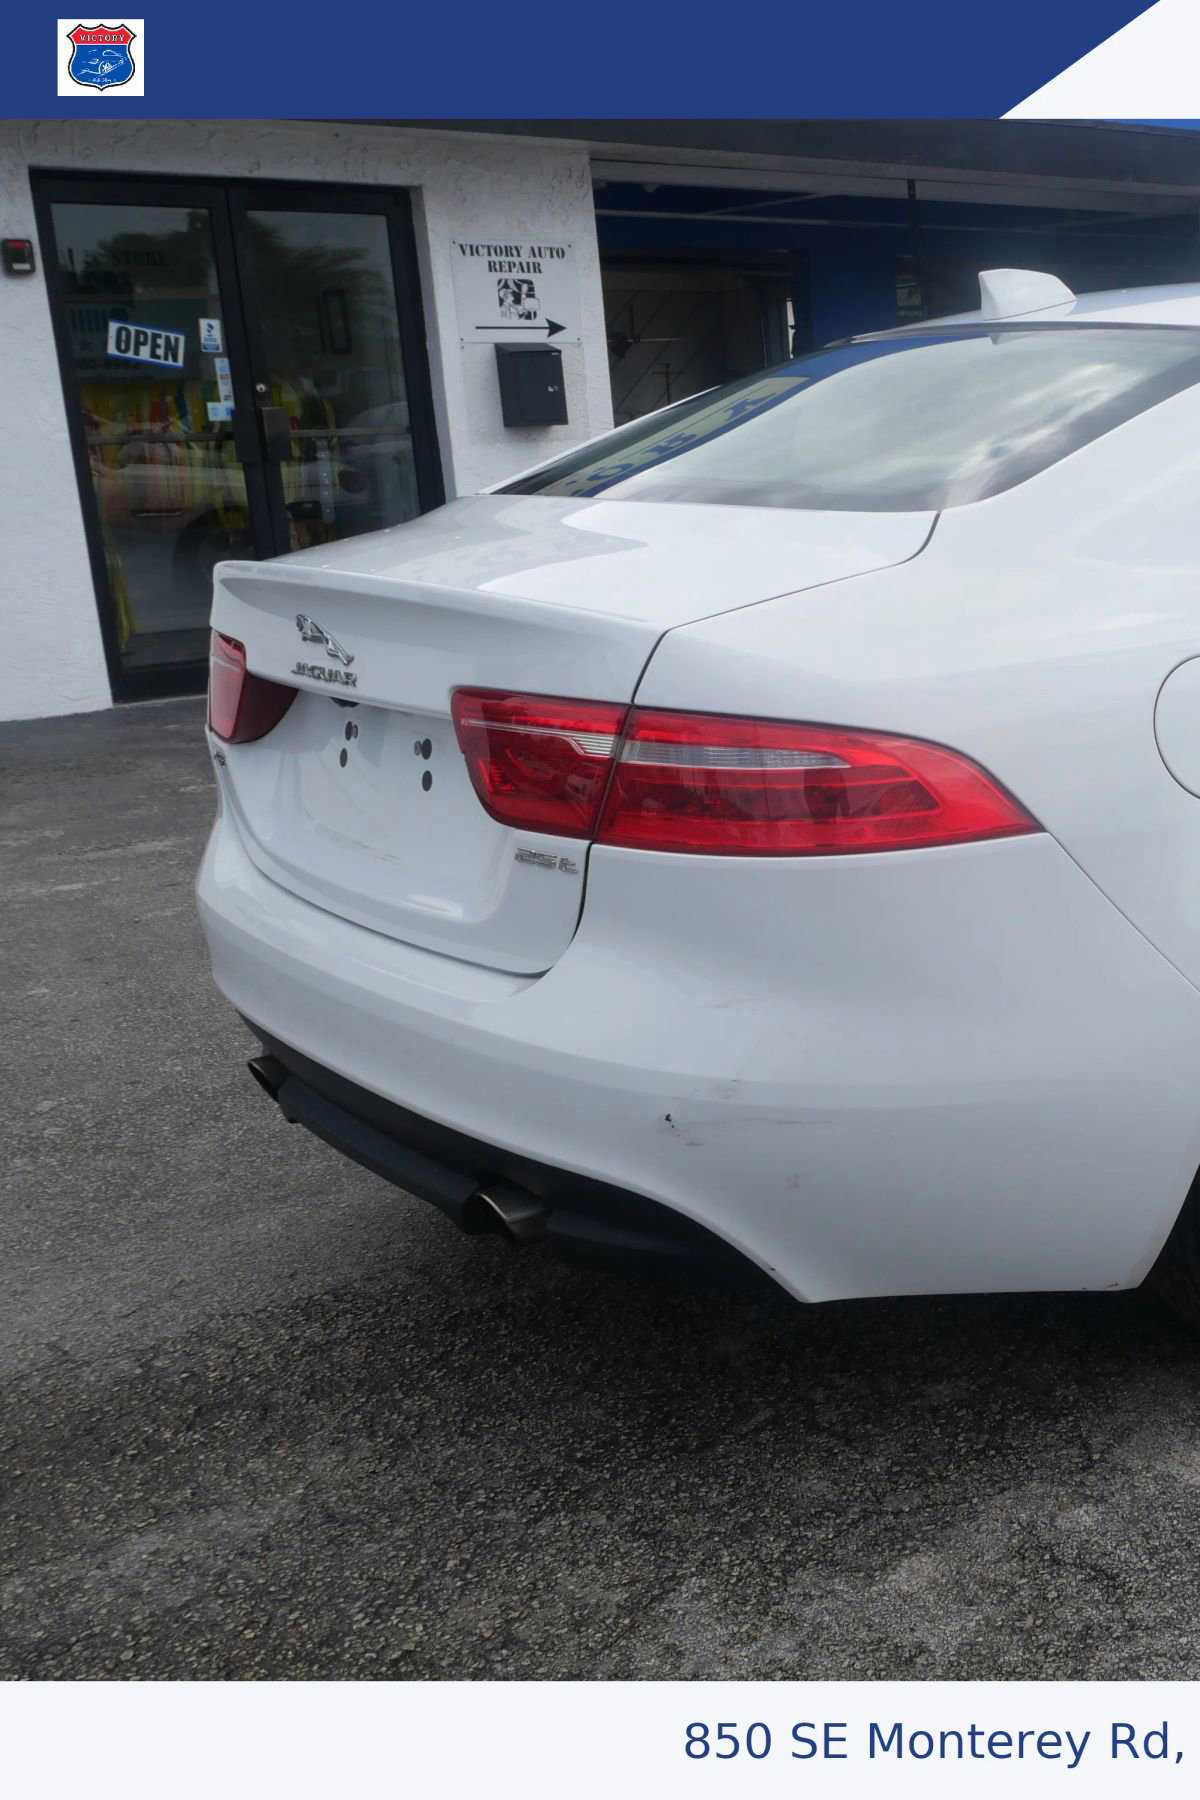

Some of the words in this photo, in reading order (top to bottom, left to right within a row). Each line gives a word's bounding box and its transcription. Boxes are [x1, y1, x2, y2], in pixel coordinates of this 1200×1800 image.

[459, 243, 523, 258] VICTORY
[528, 246, 566, 260] AUTO
[487, 260, 542, 274] REPAIR
[115, 326, 180, 363] OPEN
[290, 661, 358, 688] JAGUAR
